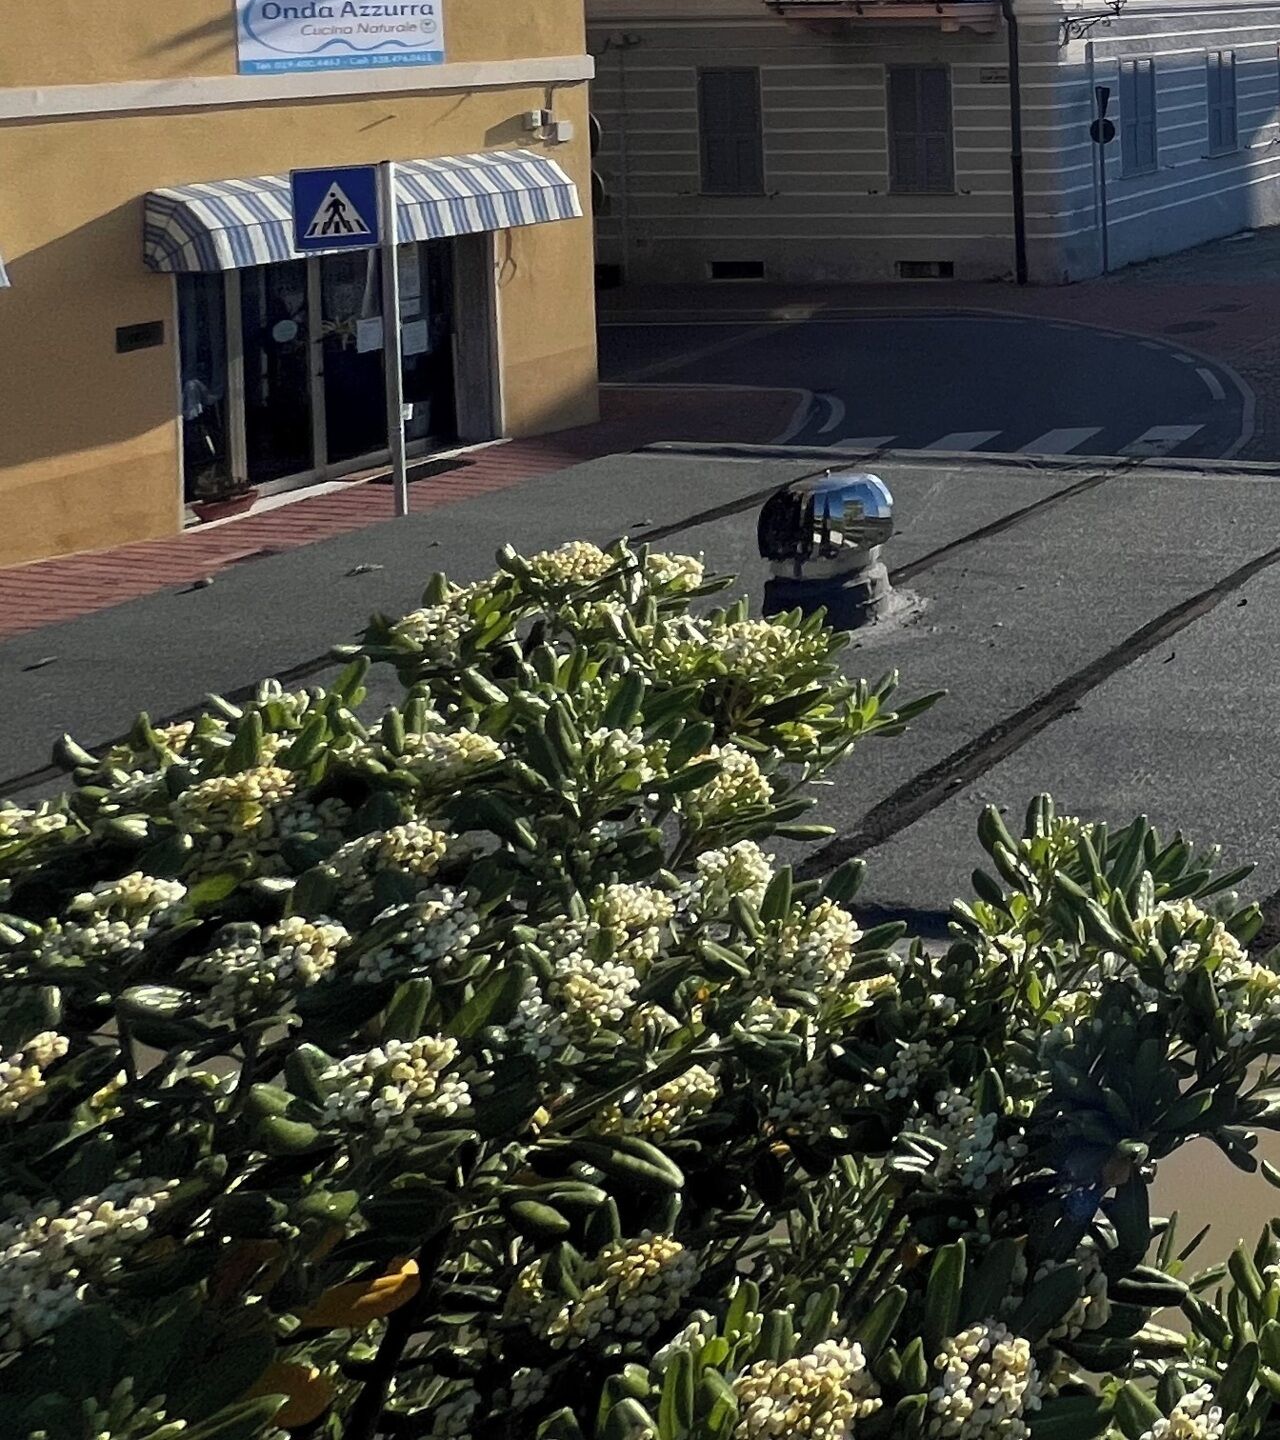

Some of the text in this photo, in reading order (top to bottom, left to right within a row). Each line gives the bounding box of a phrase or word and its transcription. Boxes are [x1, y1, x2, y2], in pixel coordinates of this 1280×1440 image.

[262, 1, 434, 20] Onda Azzurra
[300, 22, 417, 36] Cucina Naturale
